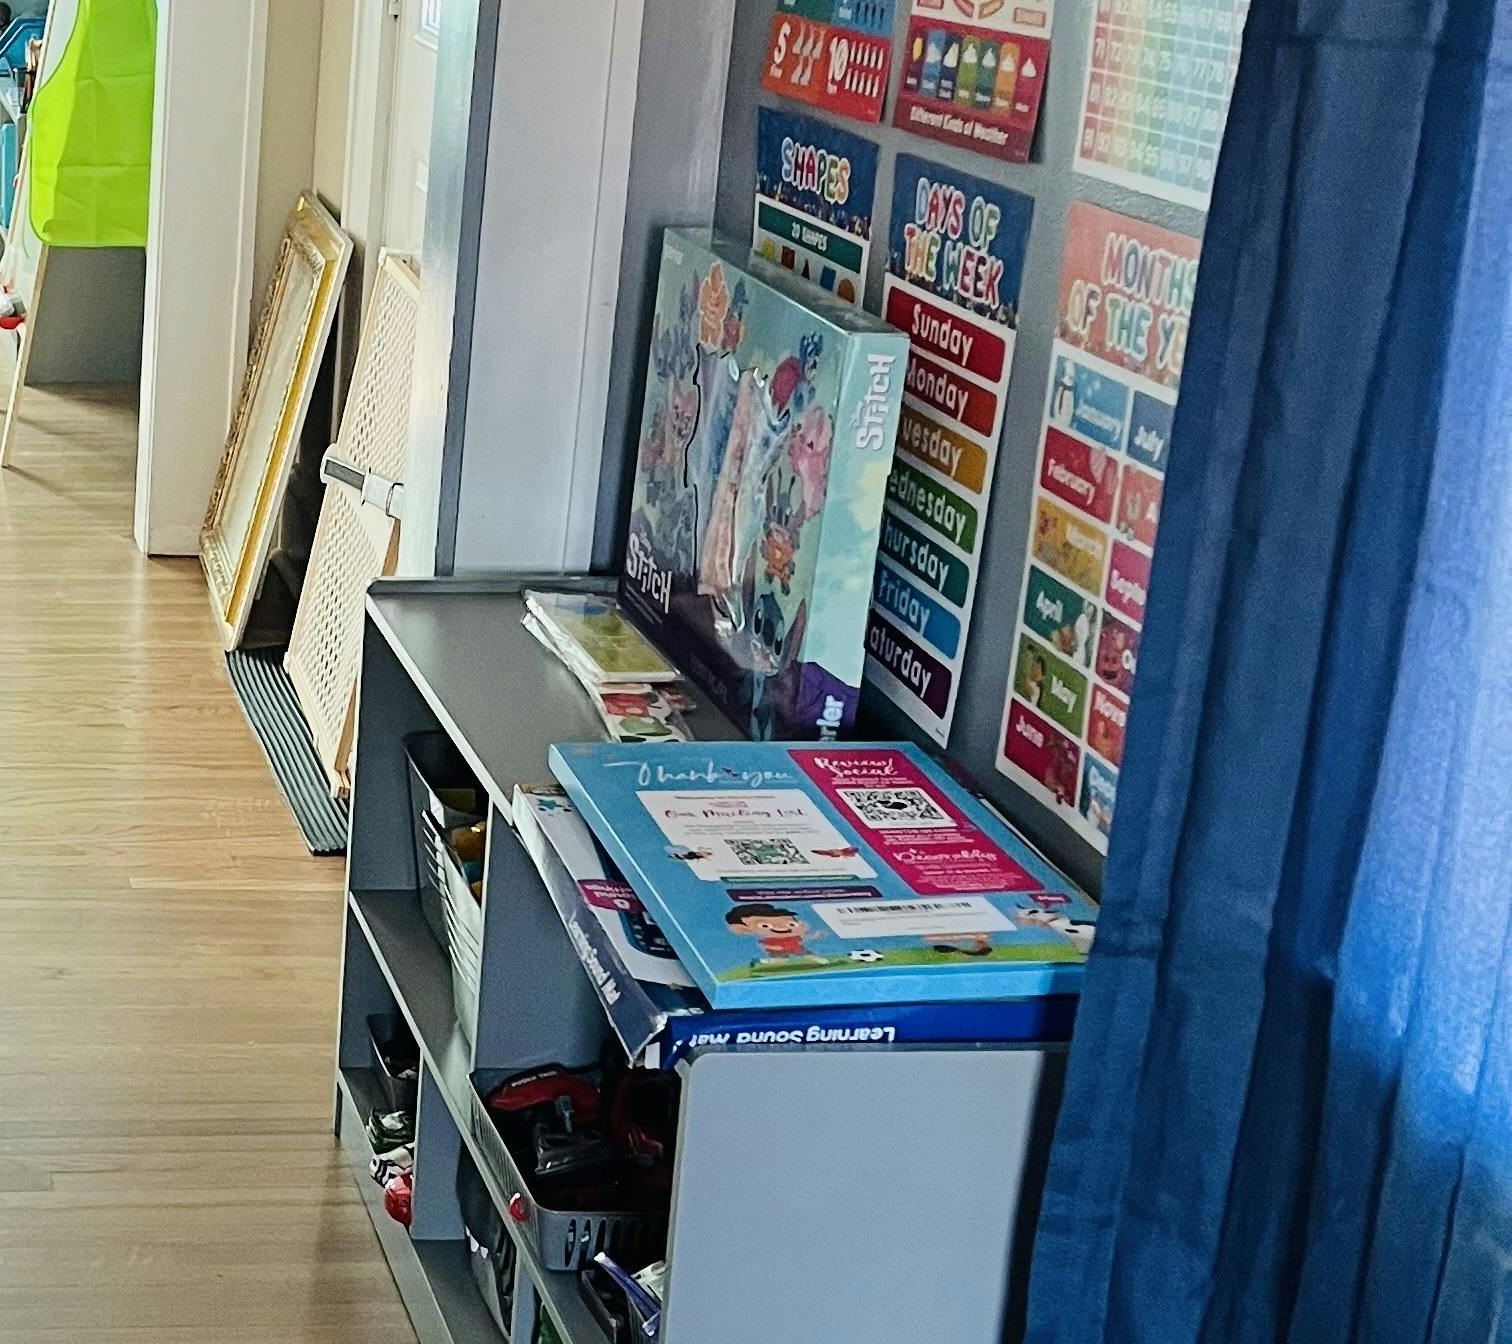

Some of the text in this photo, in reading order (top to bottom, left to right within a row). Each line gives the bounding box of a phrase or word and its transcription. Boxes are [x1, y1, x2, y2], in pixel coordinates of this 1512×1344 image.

[773, 21, 849, 82] 5 10
[780, 136, 851, 205] SHAPES
[915, 176, 1001, 251] DAYS OF
[904, 222, 1004, 310] THE WEEK
[911, 303, 974, 367] Sunday
[1068, 279, 1189, 375] OF THE YE
[901, 416, 963, 478] uesday
[1134, 425, 1164, 461] July
[889, 469, 969, 544] ednesday
[1048, 458, 1096, 506] February
[884, 519, 949, 593] hursday
[878, 568, 931, 635] Friday
[1036, 591, 1064, 624] April
[869, 626, 931, 699] aturday
[1051, 674, 1077, 714] May
[1016, 715, 1045, 749] June
[602, 759, 791, 788] Thank you
[806, 1025, 896, 1043] Learning
